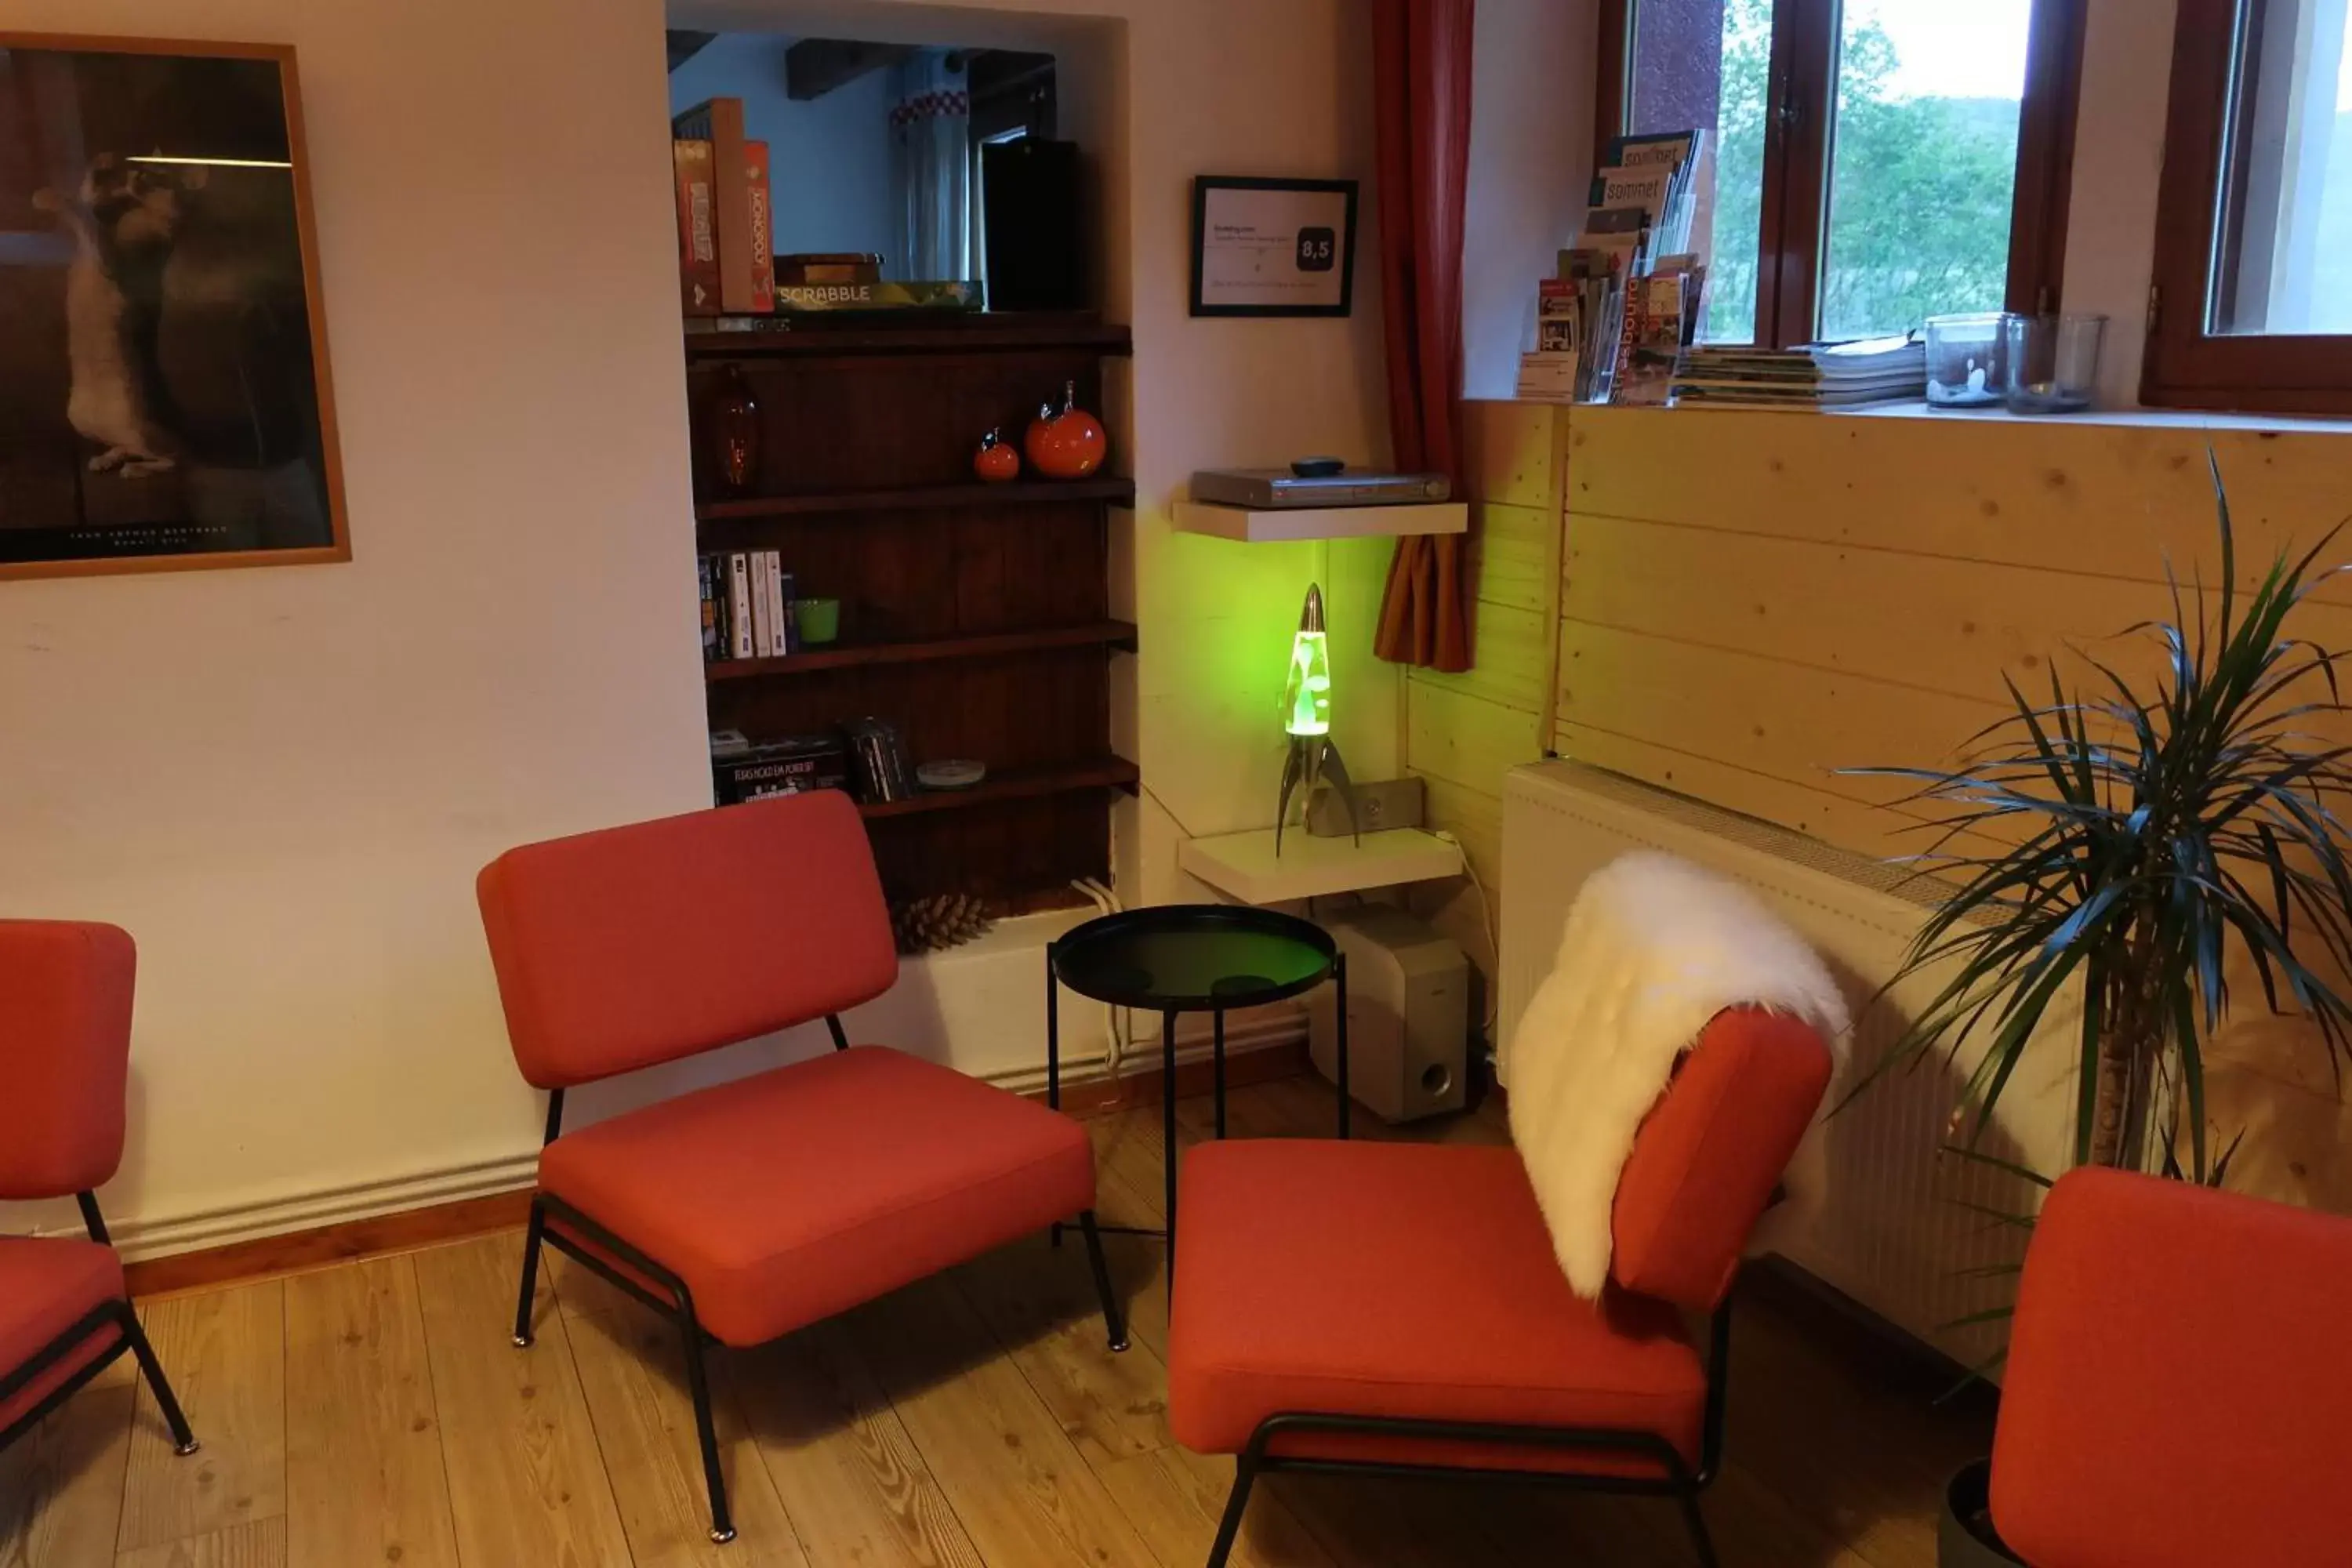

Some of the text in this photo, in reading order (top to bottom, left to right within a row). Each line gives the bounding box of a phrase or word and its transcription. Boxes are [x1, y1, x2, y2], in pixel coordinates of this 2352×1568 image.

[752, 191, 767, 265] MONOPOLY
[1301, 240, 1330, 260] 8,5
[779, 285, 871, 303] SCRABBLE
